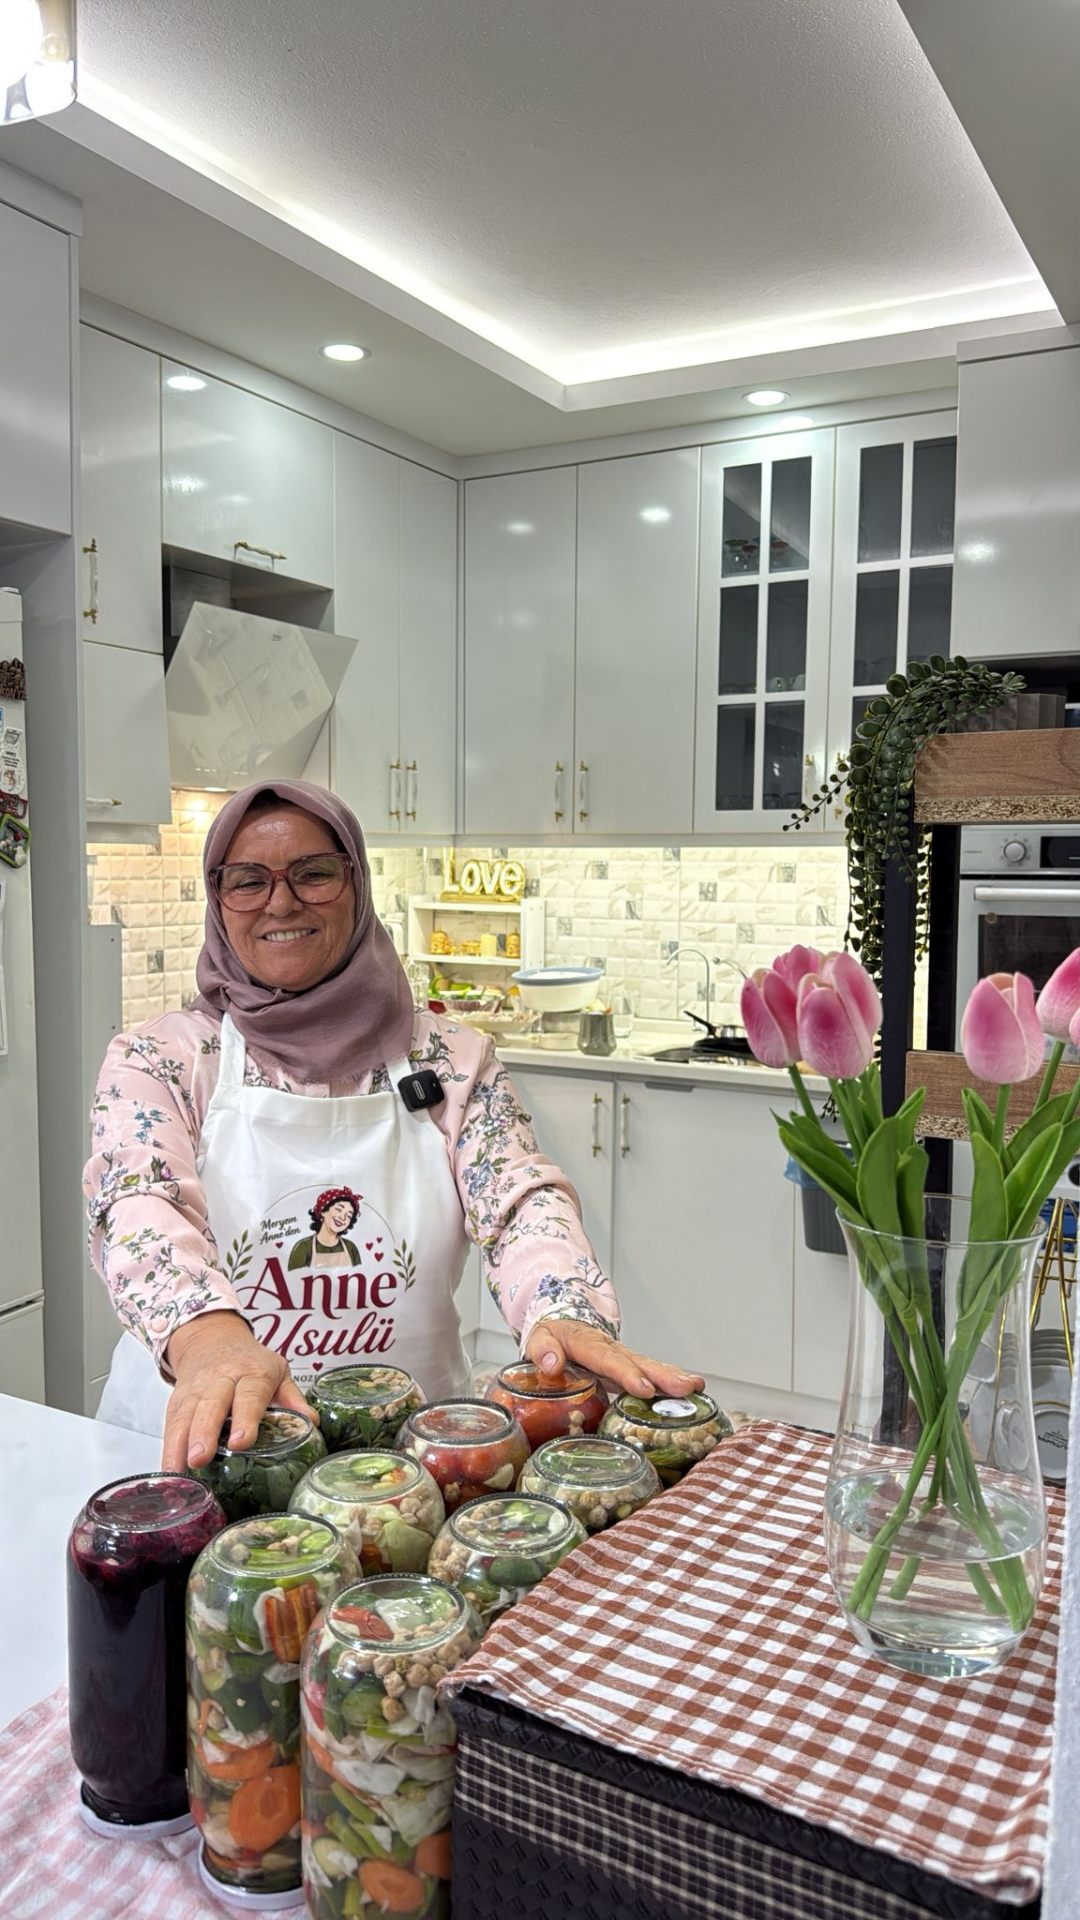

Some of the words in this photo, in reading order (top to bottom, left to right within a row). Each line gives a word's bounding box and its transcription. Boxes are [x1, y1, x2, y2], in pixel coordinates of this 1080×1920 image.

[443, 847, 525, 895] Love
[260, 1217, 297, 1231] Meryem
[236, 1257, 397, 1319] Anne
[251, 1312, 396, 1362] Usulü
